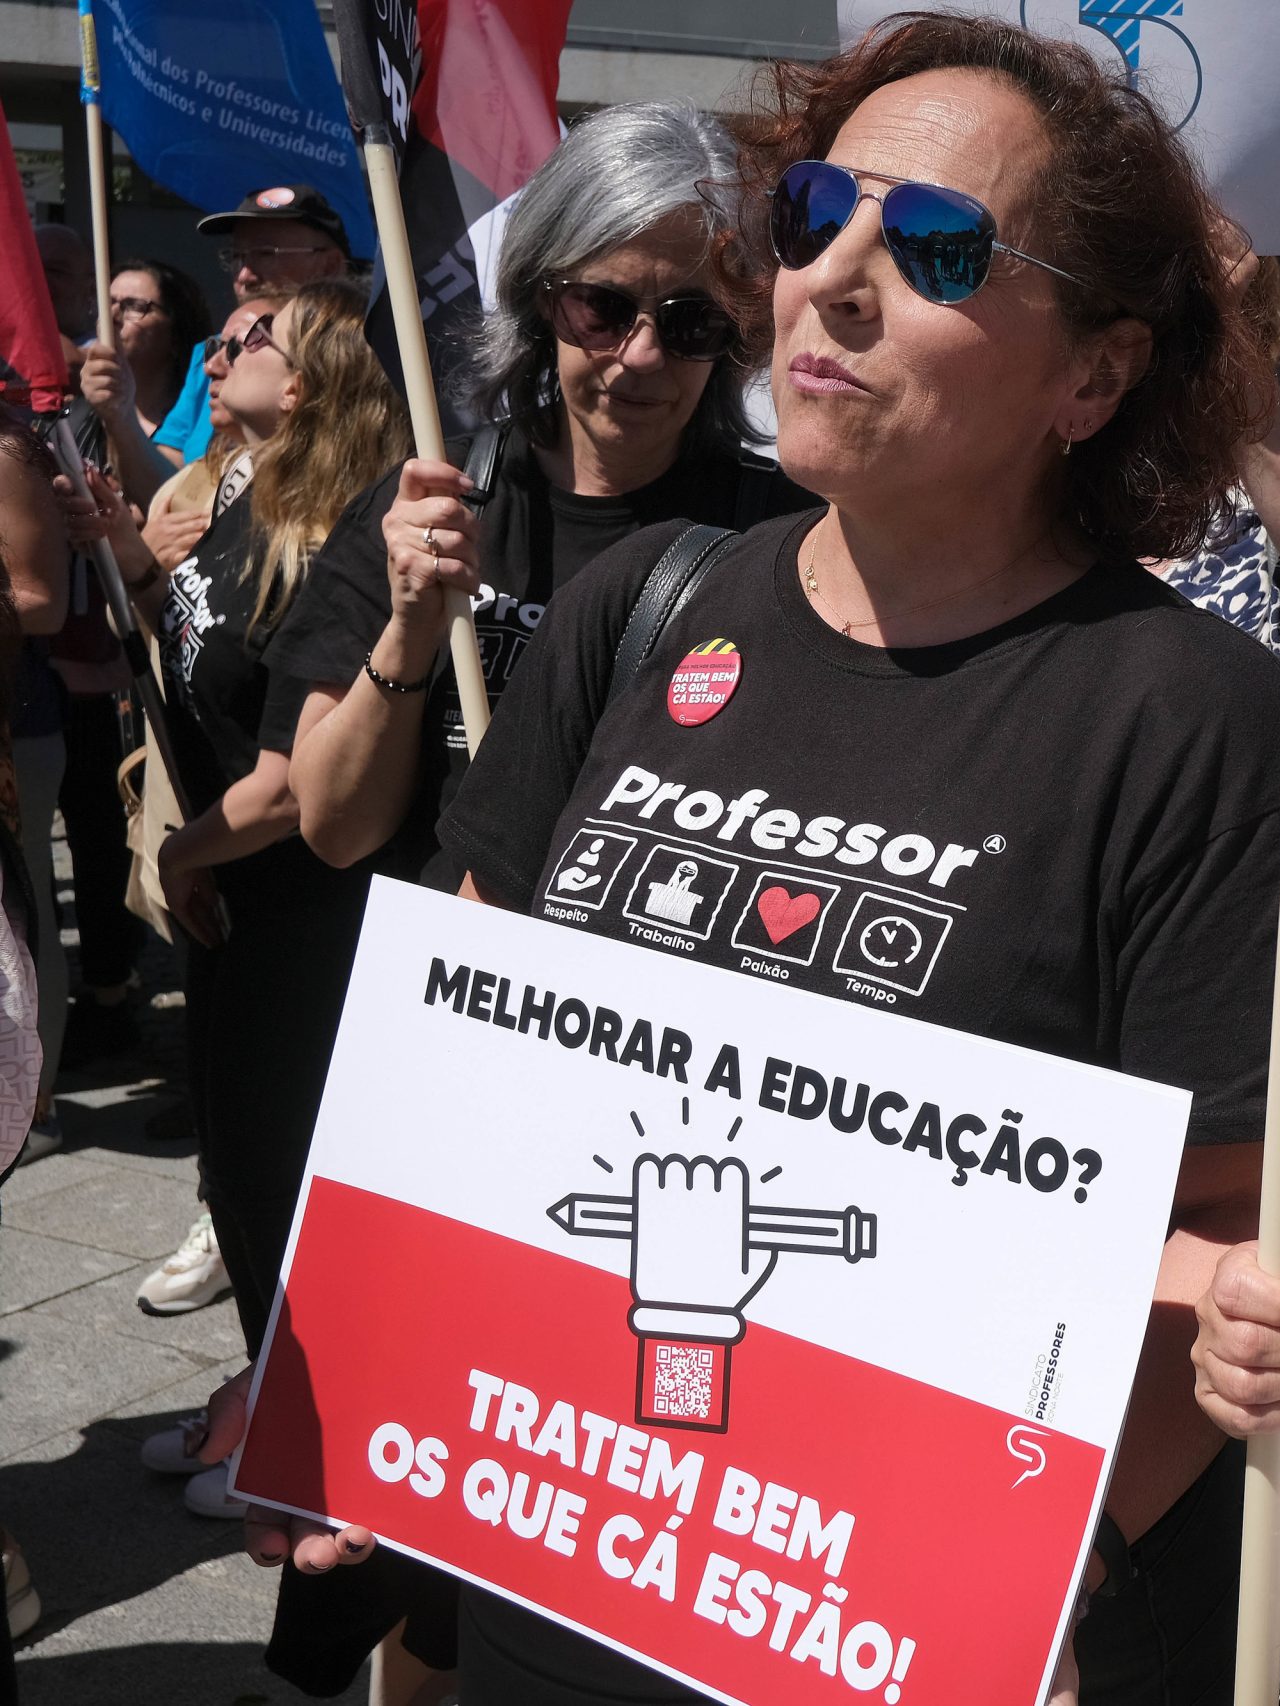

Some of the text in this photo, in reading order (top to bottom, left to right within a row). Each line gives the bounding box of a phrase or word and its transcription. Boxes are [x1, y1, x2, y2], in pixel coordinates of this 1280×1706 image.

[161, 56, 189, 85] dos
[196, 70, 299, 125] Professores
[201, 106, 212, 122] e
[218, 109, 348, 168] Universidades
[671, 672, 710, 684] TRATEM
[673, 683, 710, 694] OS QUE
[673, 691, 726, 704] CÁ ESTÃO!
[600, 766, 979, 888] Professor
[543, 903, 589, 923] Respeito
[628, 922, 695, 952] Trabalho
[740, 957, 790, 981] Paixão
[846, 977, 897, 1004] Tempo
[424, 957, 1103, 1204] MELHORAR A EDUCAÇÃO?
[1025, 1354, 1047, 1416] SINDICATO
[1035, 1322, 1066, 1420] PROFESSORES
[467, 1368, 856, 1578] TRATEM BEM
[367, 1421, 917, 1705] OS QUE CÁ ESTÃO!
